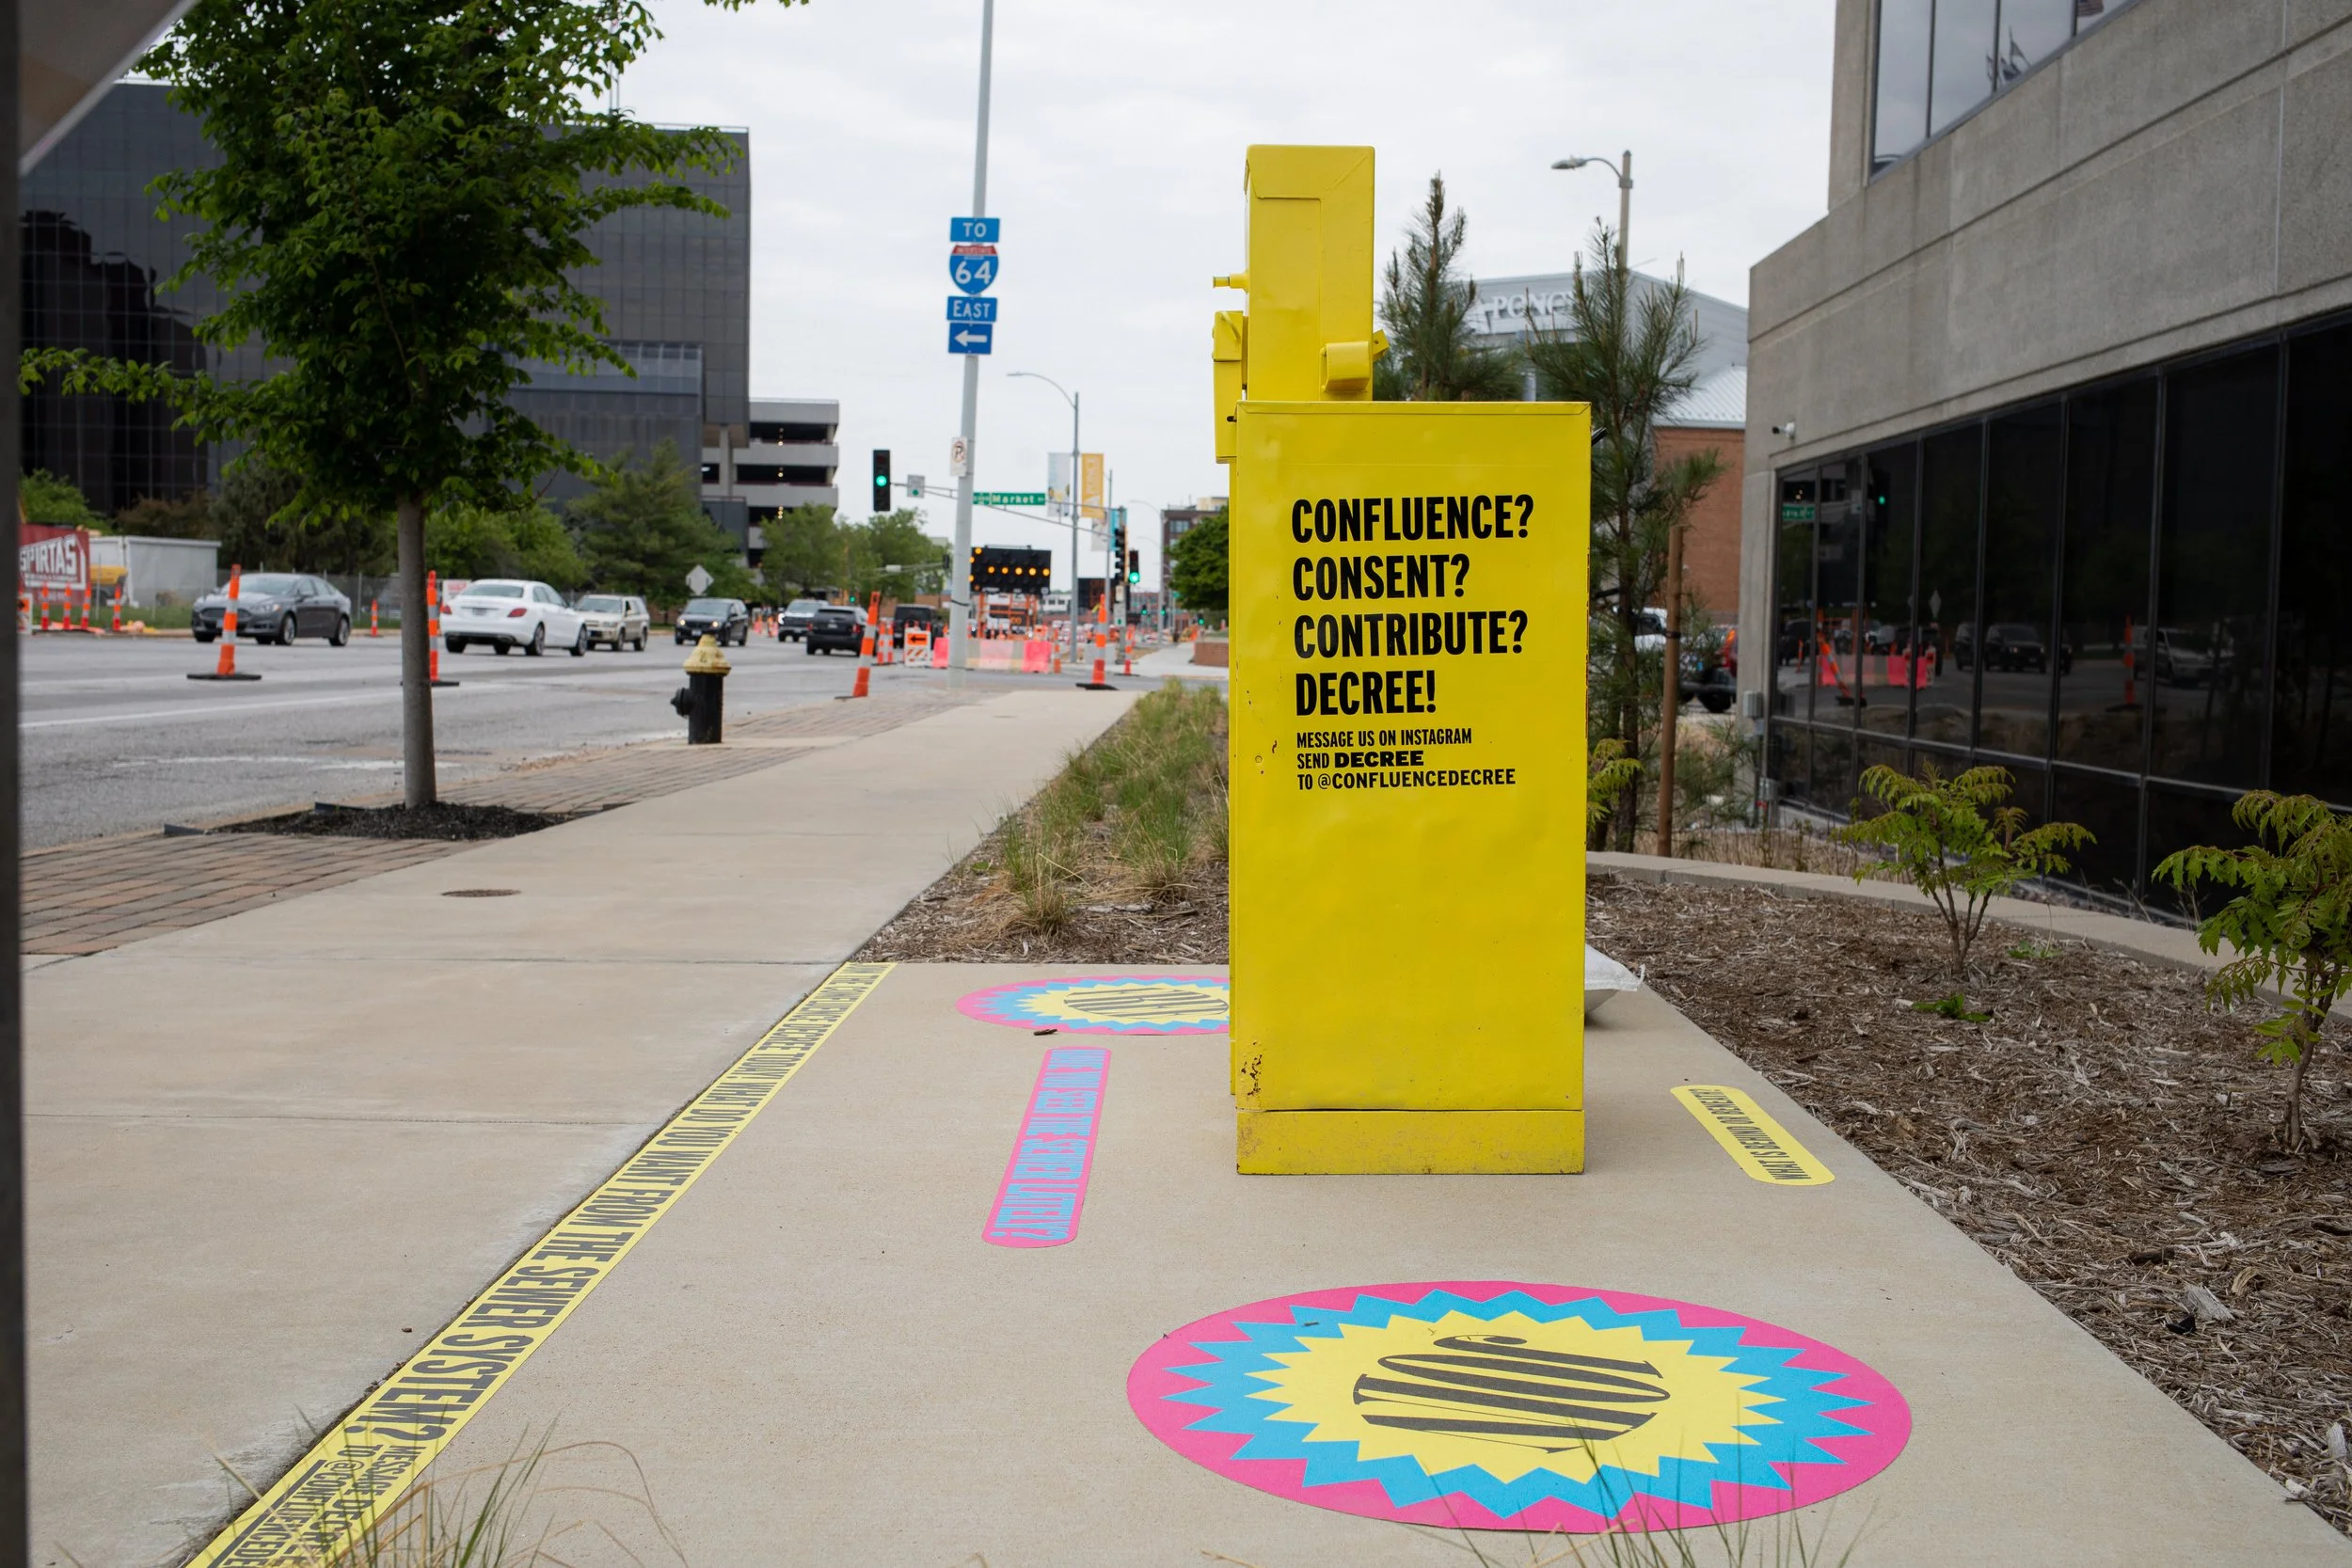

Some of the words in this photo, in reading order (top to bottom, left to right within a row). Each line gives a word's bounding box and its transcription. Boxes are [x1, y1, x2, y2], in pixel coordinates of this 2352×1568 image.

[962, 222, 987, 238] TO
[955, 260, 992, 285] 64
[952, 299, 991, 319] EAST
[1291, 494, 1534, 544] CONFLUENCE?
[20, 533, 76, 576] SPIRTAS
[1293, 553, 1470, 601] CONSENT?
[1294, 610, 1528, 658] CONTRIBUTE?
[1295, 670, 1436, 717] DECREE!
[1296, 731, 1354, 748] MESSAGE
[1358, 730, 1375, 747] US
[1378, 730, 1396, 746] ON
[1400, 728, 1472, 745] INSTAGRAM
[1296, 753, 1330, 769] SEND
[1334, 751, 1424, 768] DECREE
[1297, 773, 1313, 790] TO
[1317, 768, 1516, 789] @CONFLUENCEDECREE
[787, 987, 870, 1022] CONFLUENCE
[755, 1023, 834, 1052] DECREE
[724, 1053, 806, 1080] TODAY!
[1047, 1050, 1106, 1069] HAVE
[1041, 1071, 1102, 1088] YOU
[698, 1082, 778, 1107] WHAT
[1033, 1090, 1098, 1114] SEEN
[680, 1109, 753, 1123] DO
[1026, 1117, 1092, 1136] THE
[1716, 1116, 1755, 1124] OR
[655, 1125, 739, 1148] YOU
[1726, 1126, 1781, 1149] BEHIND
[614, 1150, 715, 1187] WANT
[1011, 1138, 1089, 1180] SEWER
[1757, 1160, 1812, 1180] WHAT
[566, 1187, 677, 1228] FROM
[989, 1183, 1078, 1242] LATELY?
[531, 1231, 637, 1263] THE
[457, 1265, 602, 1329] SEWER
[342, 1333, 535, 1442] SYSTEM?
[1353, 1334, 1671, 1454] JOIN
[336, 1444, 378, 1456] TO
[345, 1445, 427, 1497] MESSAGE
